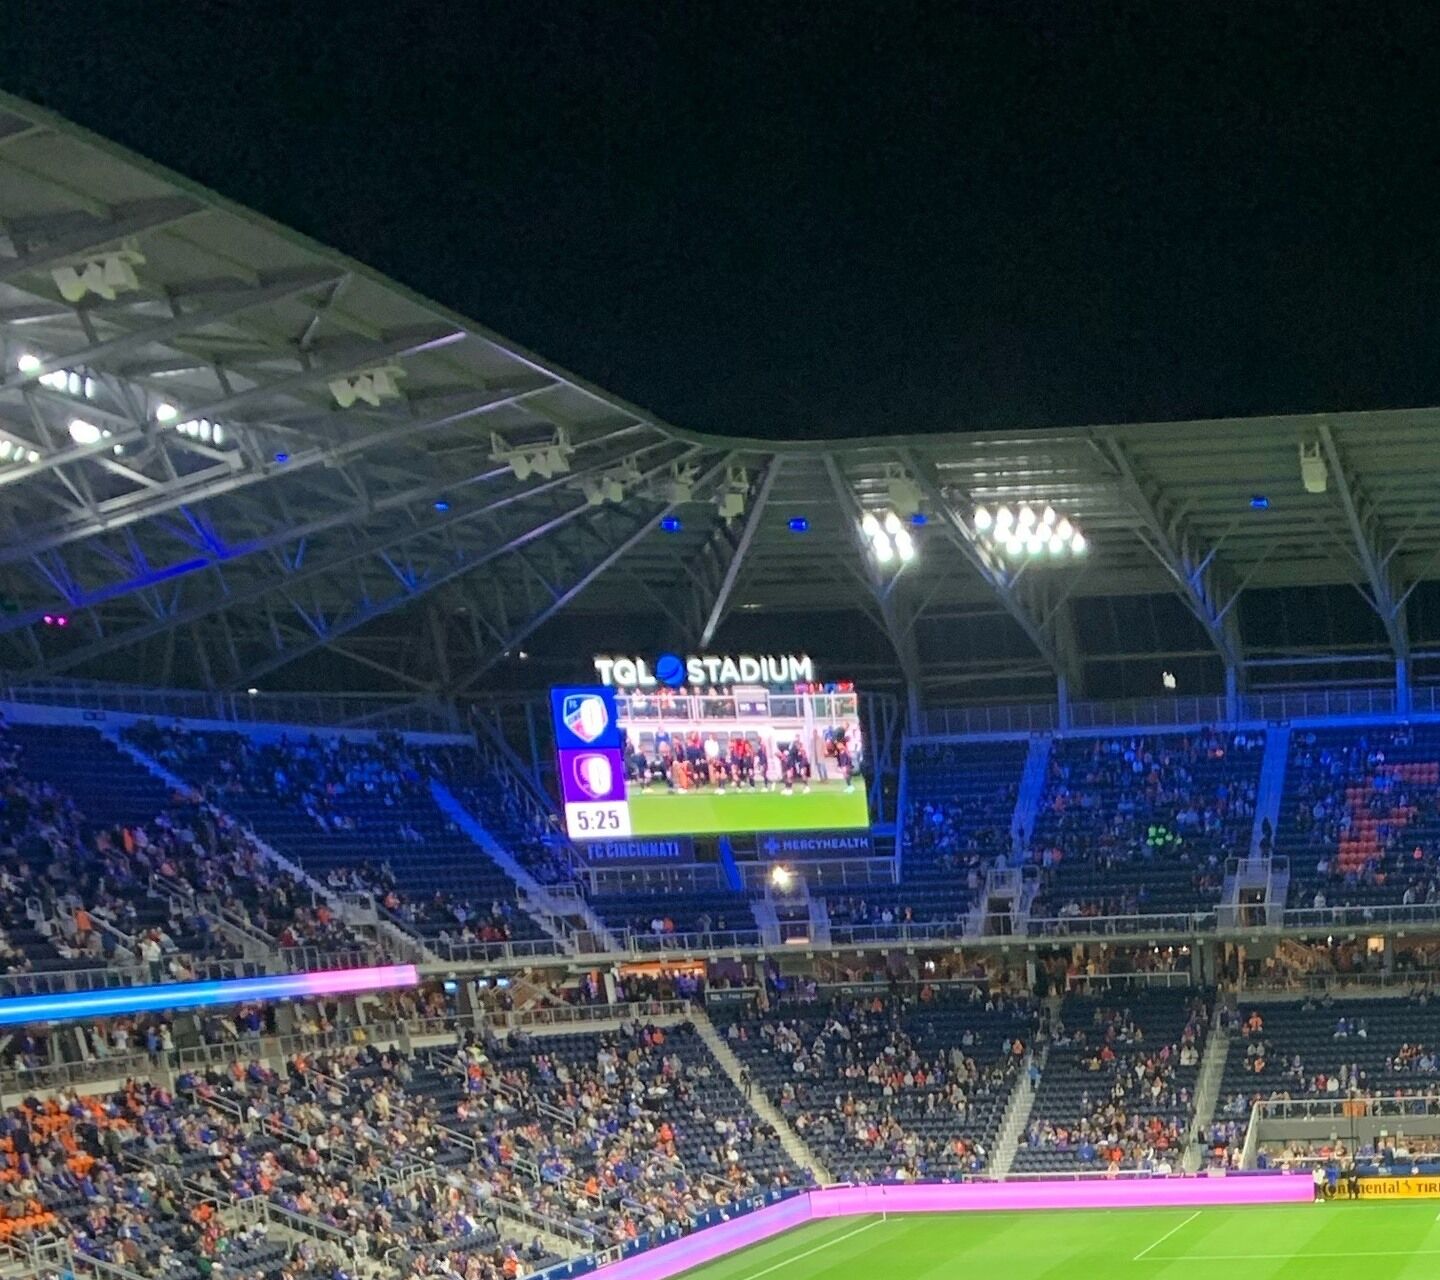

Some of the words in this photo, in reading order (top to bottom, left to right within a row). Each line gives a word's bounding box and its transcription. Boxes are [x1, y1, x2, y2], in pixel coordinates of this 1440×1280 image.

[595, 657, 656, 685] TQL
[687, 655, 813, 685] STADIUM
[577, 809, 621, 830] 5:25
[782, 837, 869, 850] MERCYHEALTH
